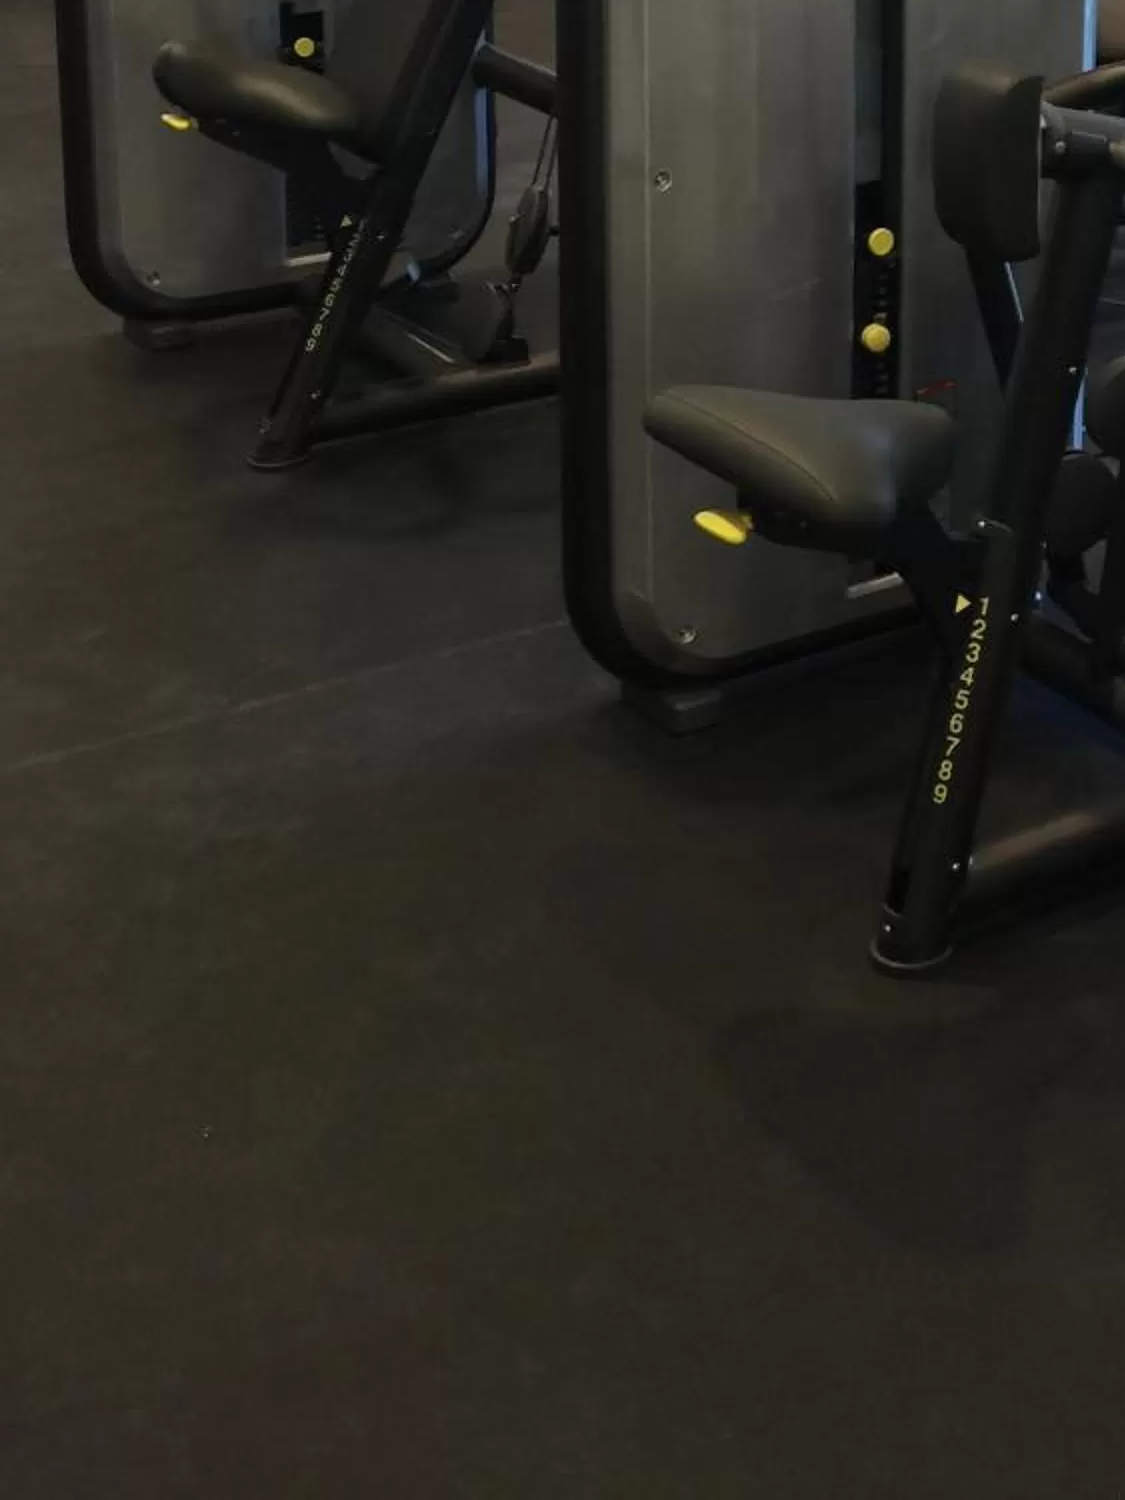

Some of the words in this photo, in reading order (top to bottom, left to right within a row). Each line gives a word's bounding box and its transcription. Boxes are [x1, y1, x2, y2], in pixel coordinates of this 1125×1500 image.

[980, 597, 990, 616] 1
[970, 619, 987, 640] 2
[965, 642, 981, 663] 3
[960, 666, 975, 686] 4
[954, 689, 971, 710] 5
[950, 713, 964, 734] 6
[945, 736, 960, 757] 7
[938, 760, 953, 781] 8
[933, 783, 948, 805] 9
